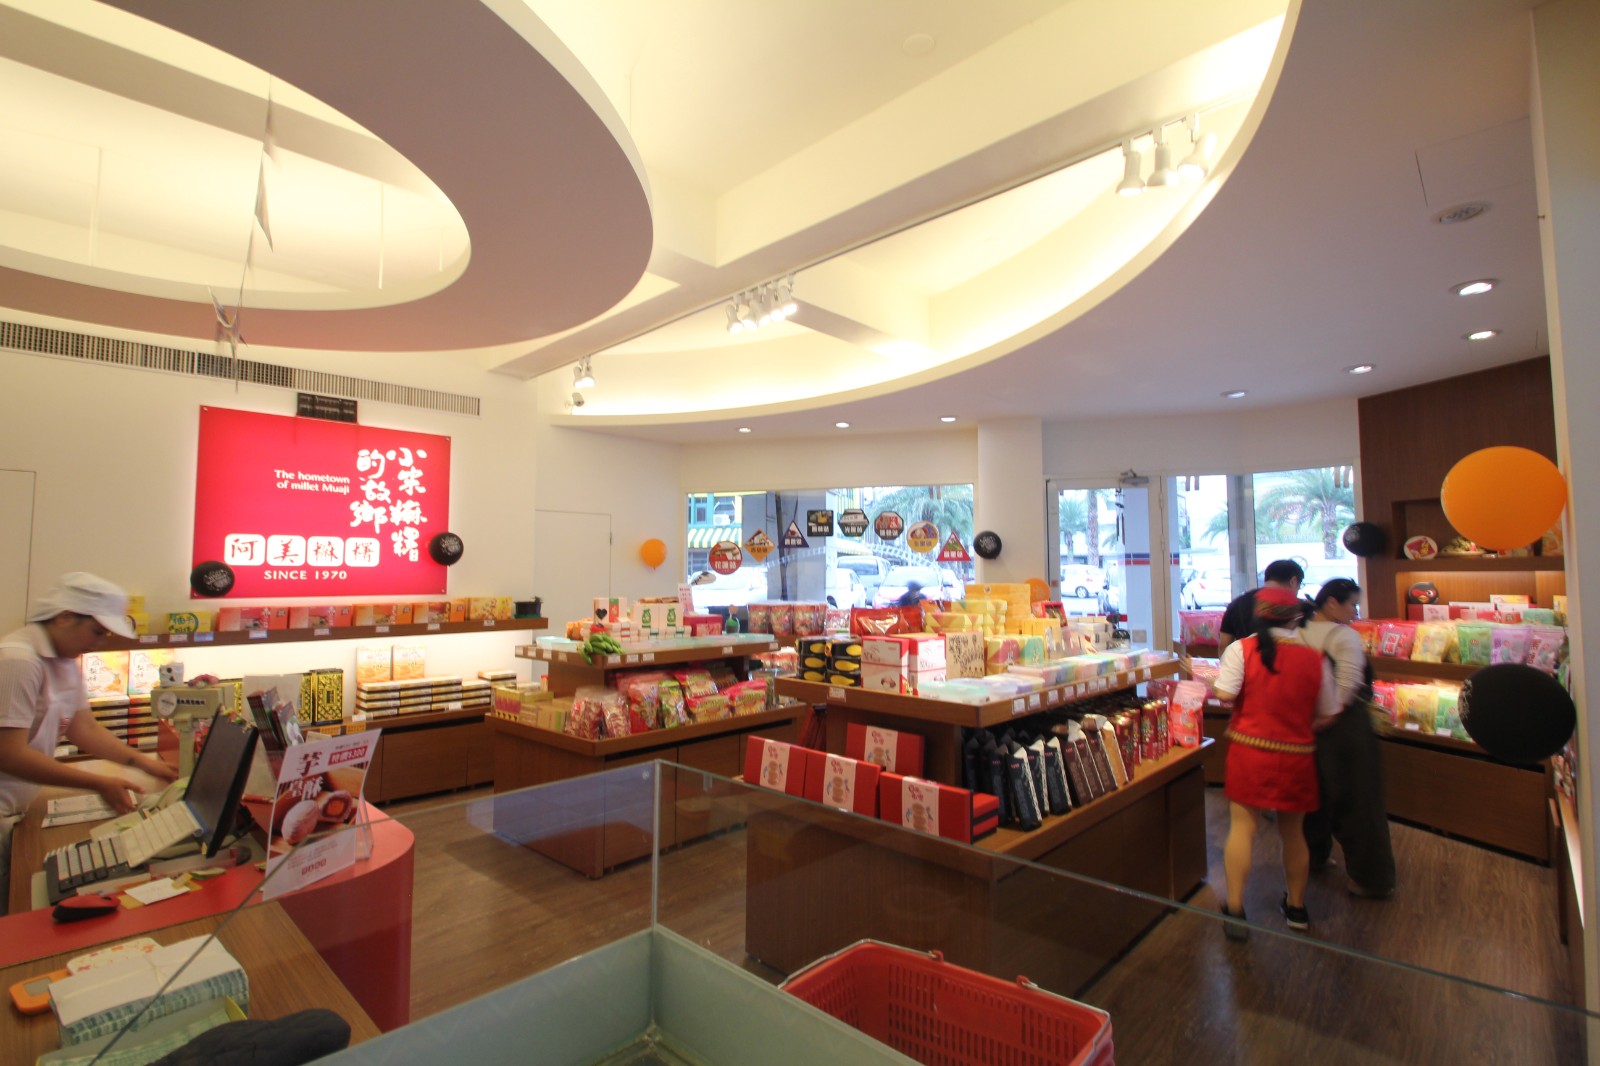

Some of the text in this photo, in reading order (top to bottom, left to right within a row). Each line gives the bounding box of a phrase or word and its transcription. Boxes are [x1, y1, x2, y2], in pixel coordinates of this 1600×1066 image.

[274, 469, 350, 484] The hometown
[276, 480, 350, 495] of millet Muaji
[264, 570, 347, 581] SINCE 1970
